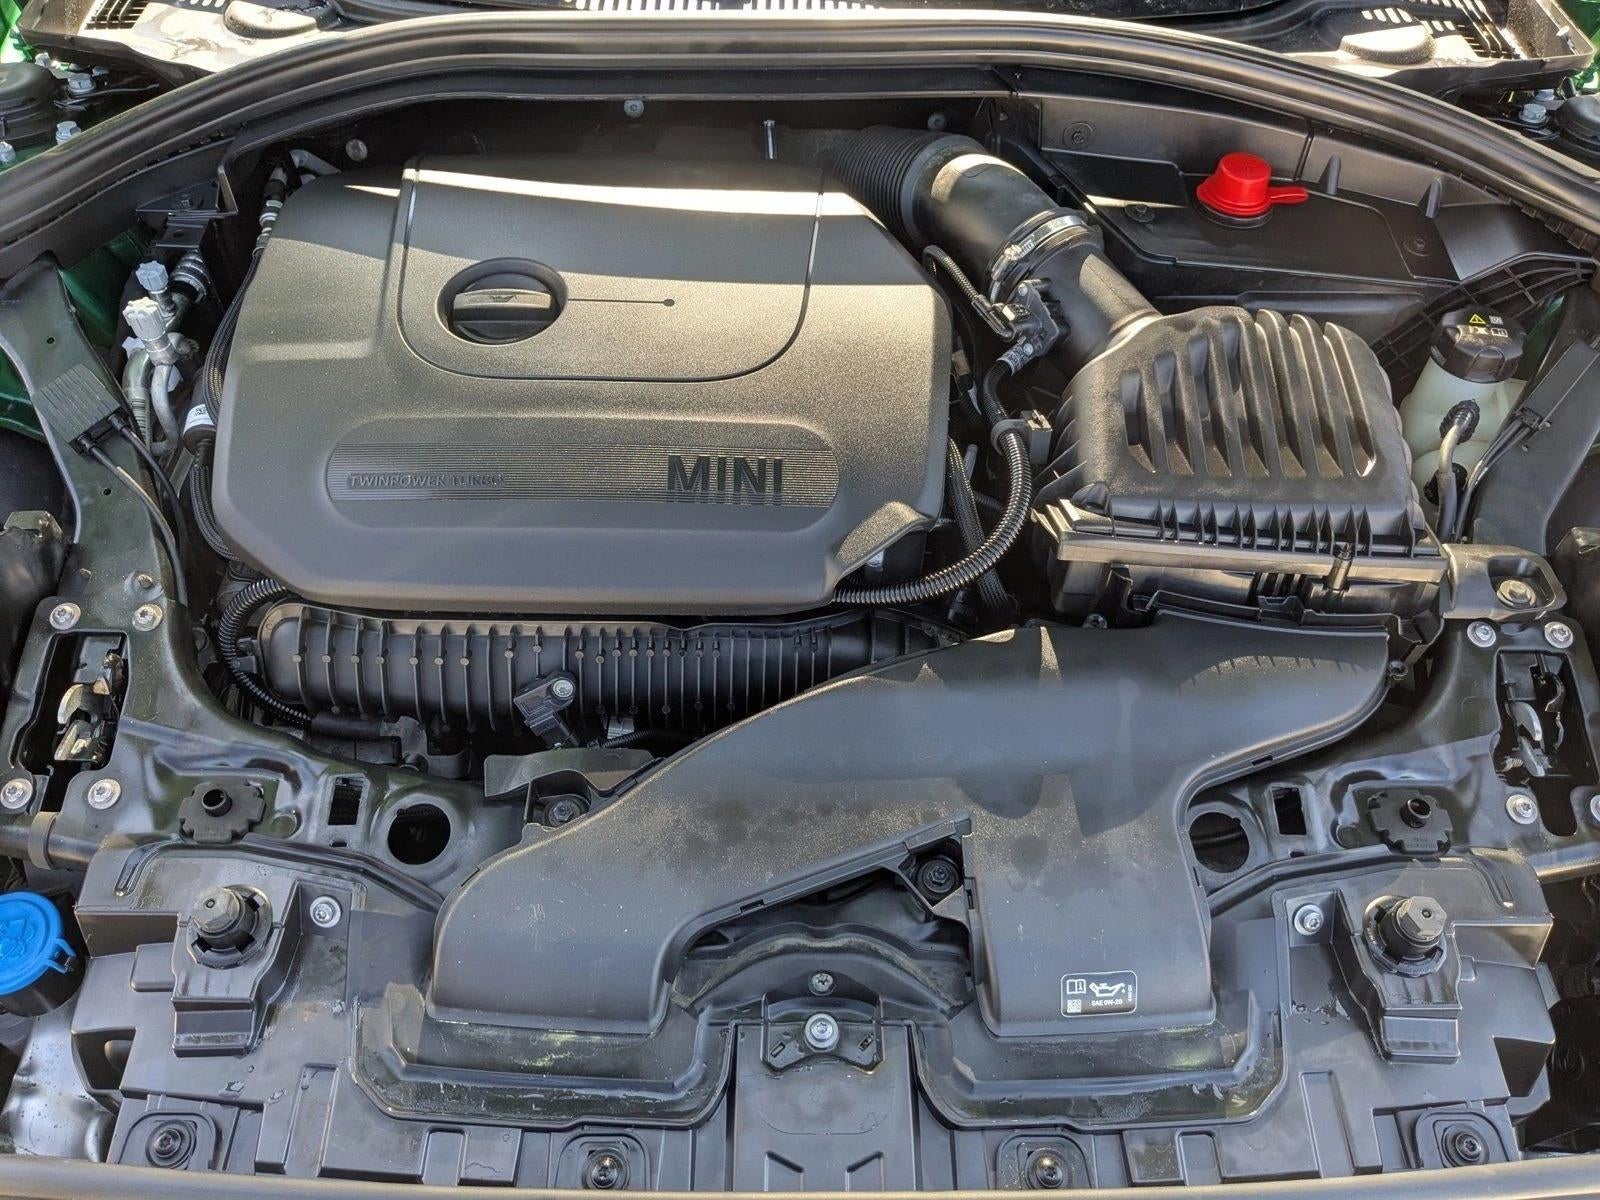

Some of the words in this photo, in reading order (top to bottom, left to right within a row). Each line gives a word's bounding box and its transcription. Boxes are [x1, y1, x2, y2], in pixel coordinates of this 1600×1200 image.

[350, 473, 446, 488] TWINPOWER
[451, 473, 504, 487] TURBO
[667, 454, 783, 500] MINI
[1091, 999, 1103, 1007] SAE
